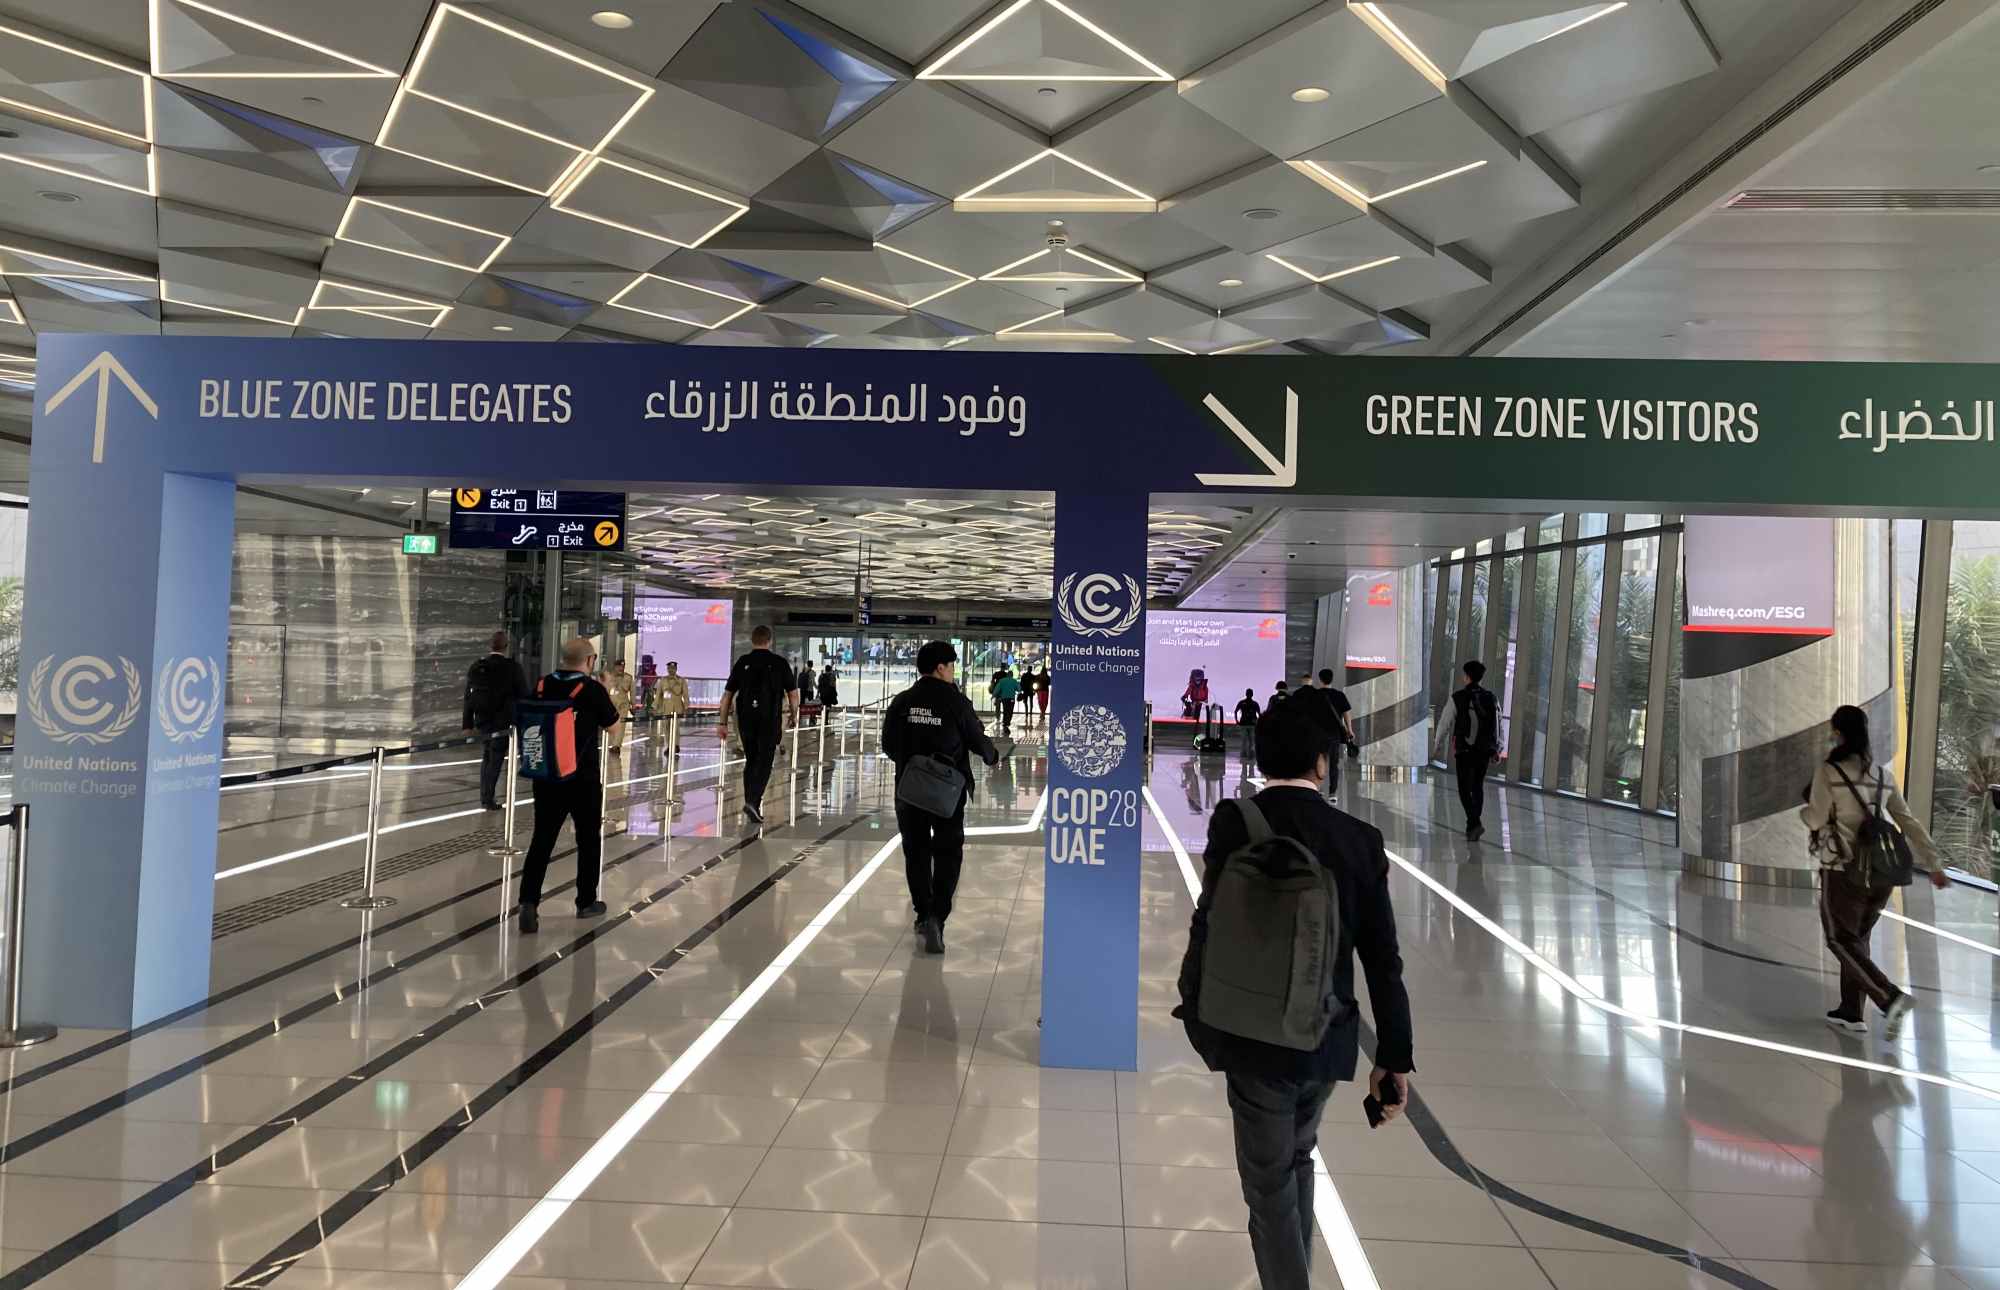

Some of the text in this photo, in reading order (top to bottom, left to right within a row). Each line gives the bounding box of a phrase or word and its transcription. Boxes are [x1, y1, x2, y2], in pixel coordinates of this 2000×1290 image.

[199, 379, 572, 424] BLUE ZONE DELEGATES
[644, 380, 1027, 437] وفود المنطقة الزرقاء
[1365, 394, 1759, 443] GREEN ZONE VISITORS
[1838, 398, 1994, 453] الخضراء
[490, 499, 510, 509] Exit
[558, 521, 584, 533] مخرج
[563, 535, 584, 546] Exit
[1690, 605, 1806, 620] Mashreq.com/ESG
[1055, 644, 1140, 657] United Nations
[1055, 660, 1140, 676] Climate Change
[23, 755, 137, 772] United Nations
[153, 752, 217, 772] United Nations
[22, 777, 137, 798] Climate Change
[1051, 787, 1137, 828] COP28
[1050, 826, 1106, 866] UAE
